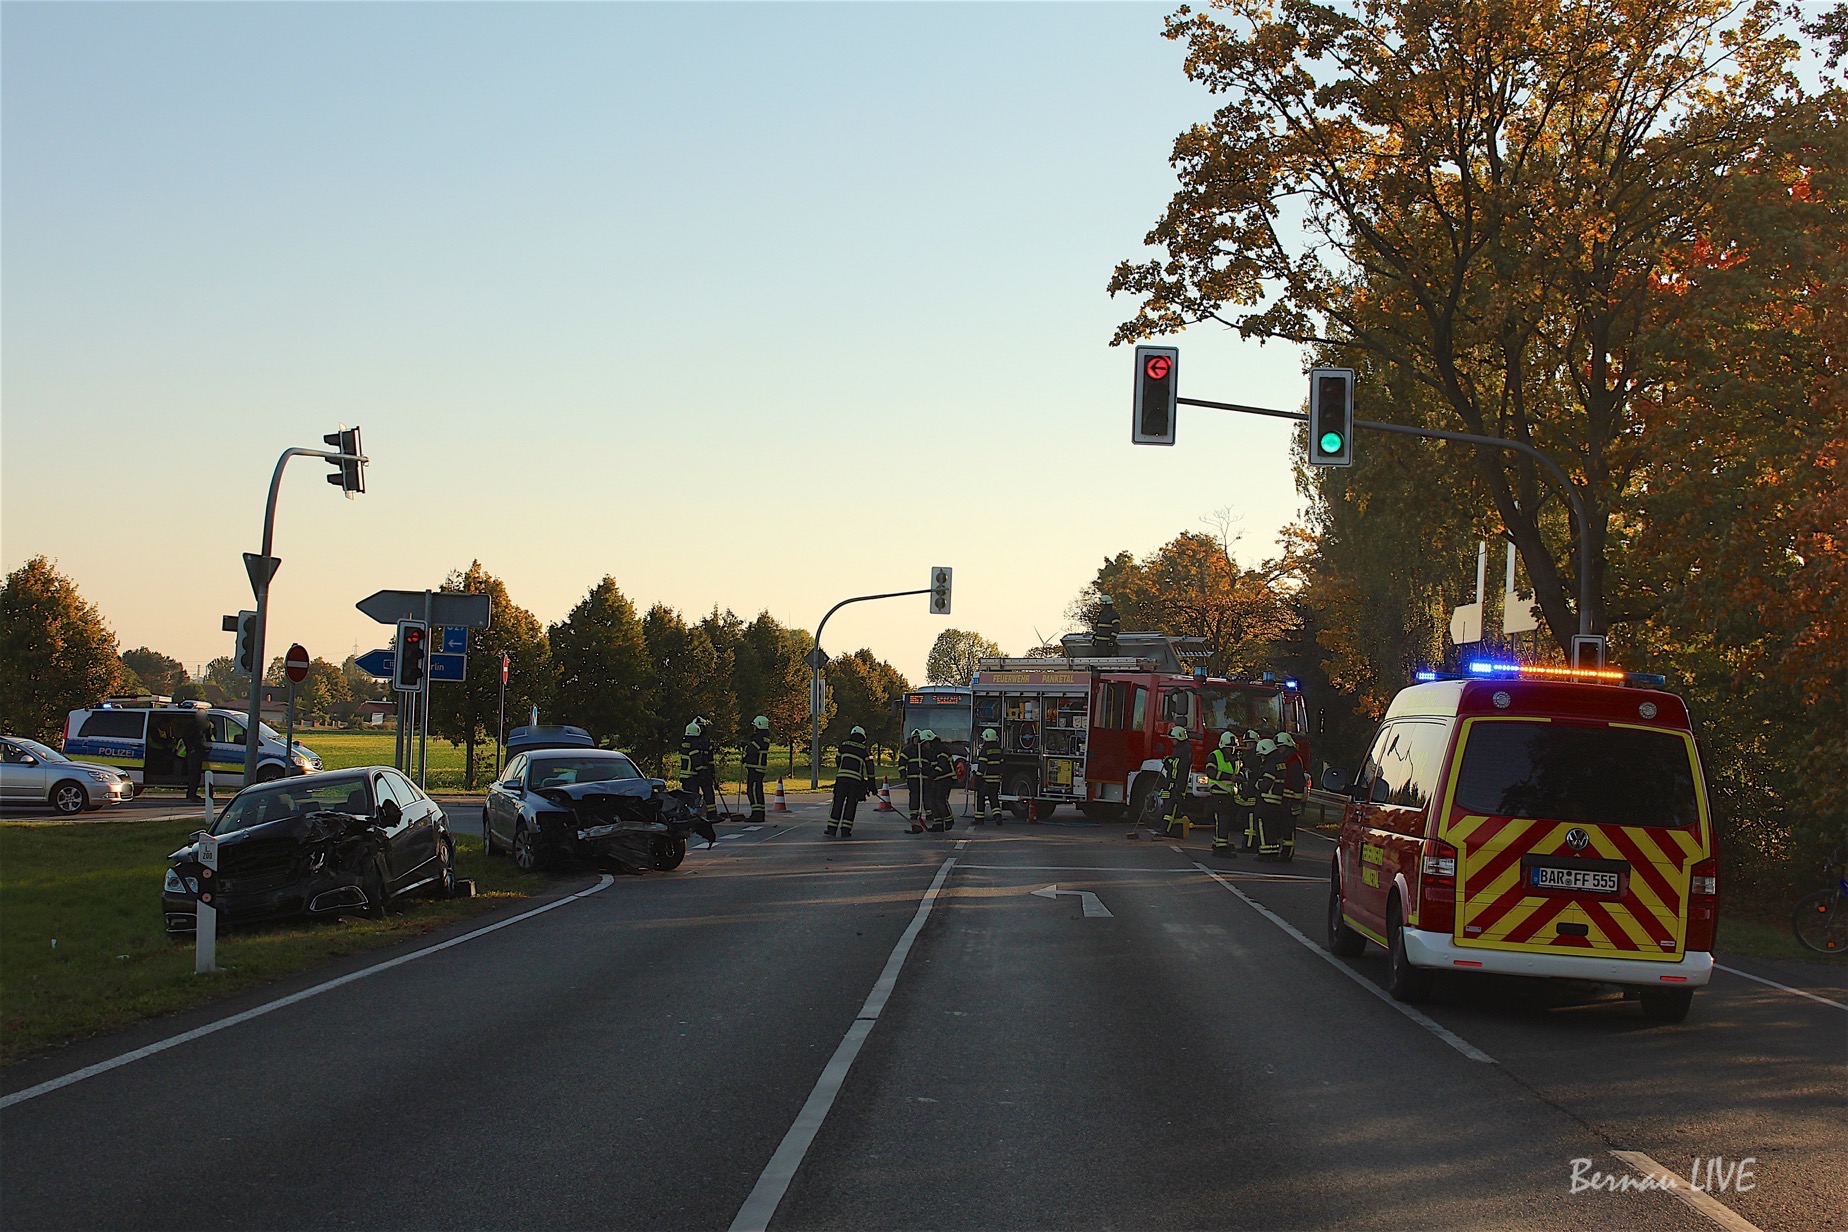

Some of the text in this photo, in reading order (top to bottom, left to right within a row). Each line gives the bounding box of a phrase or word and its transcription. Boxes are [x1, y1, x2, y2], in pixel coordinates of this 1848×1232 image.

[992, 674, 1074, 683] FEUERWEHR PANKETAL
[98, 747, 135, 757] POLIZEI
[202, 852, 213, 860] 200
[1540, 869, 1564, 886] BAR
[1573, 872, 1590, 887] FF
[1592, 873, 1616, 889] 555
